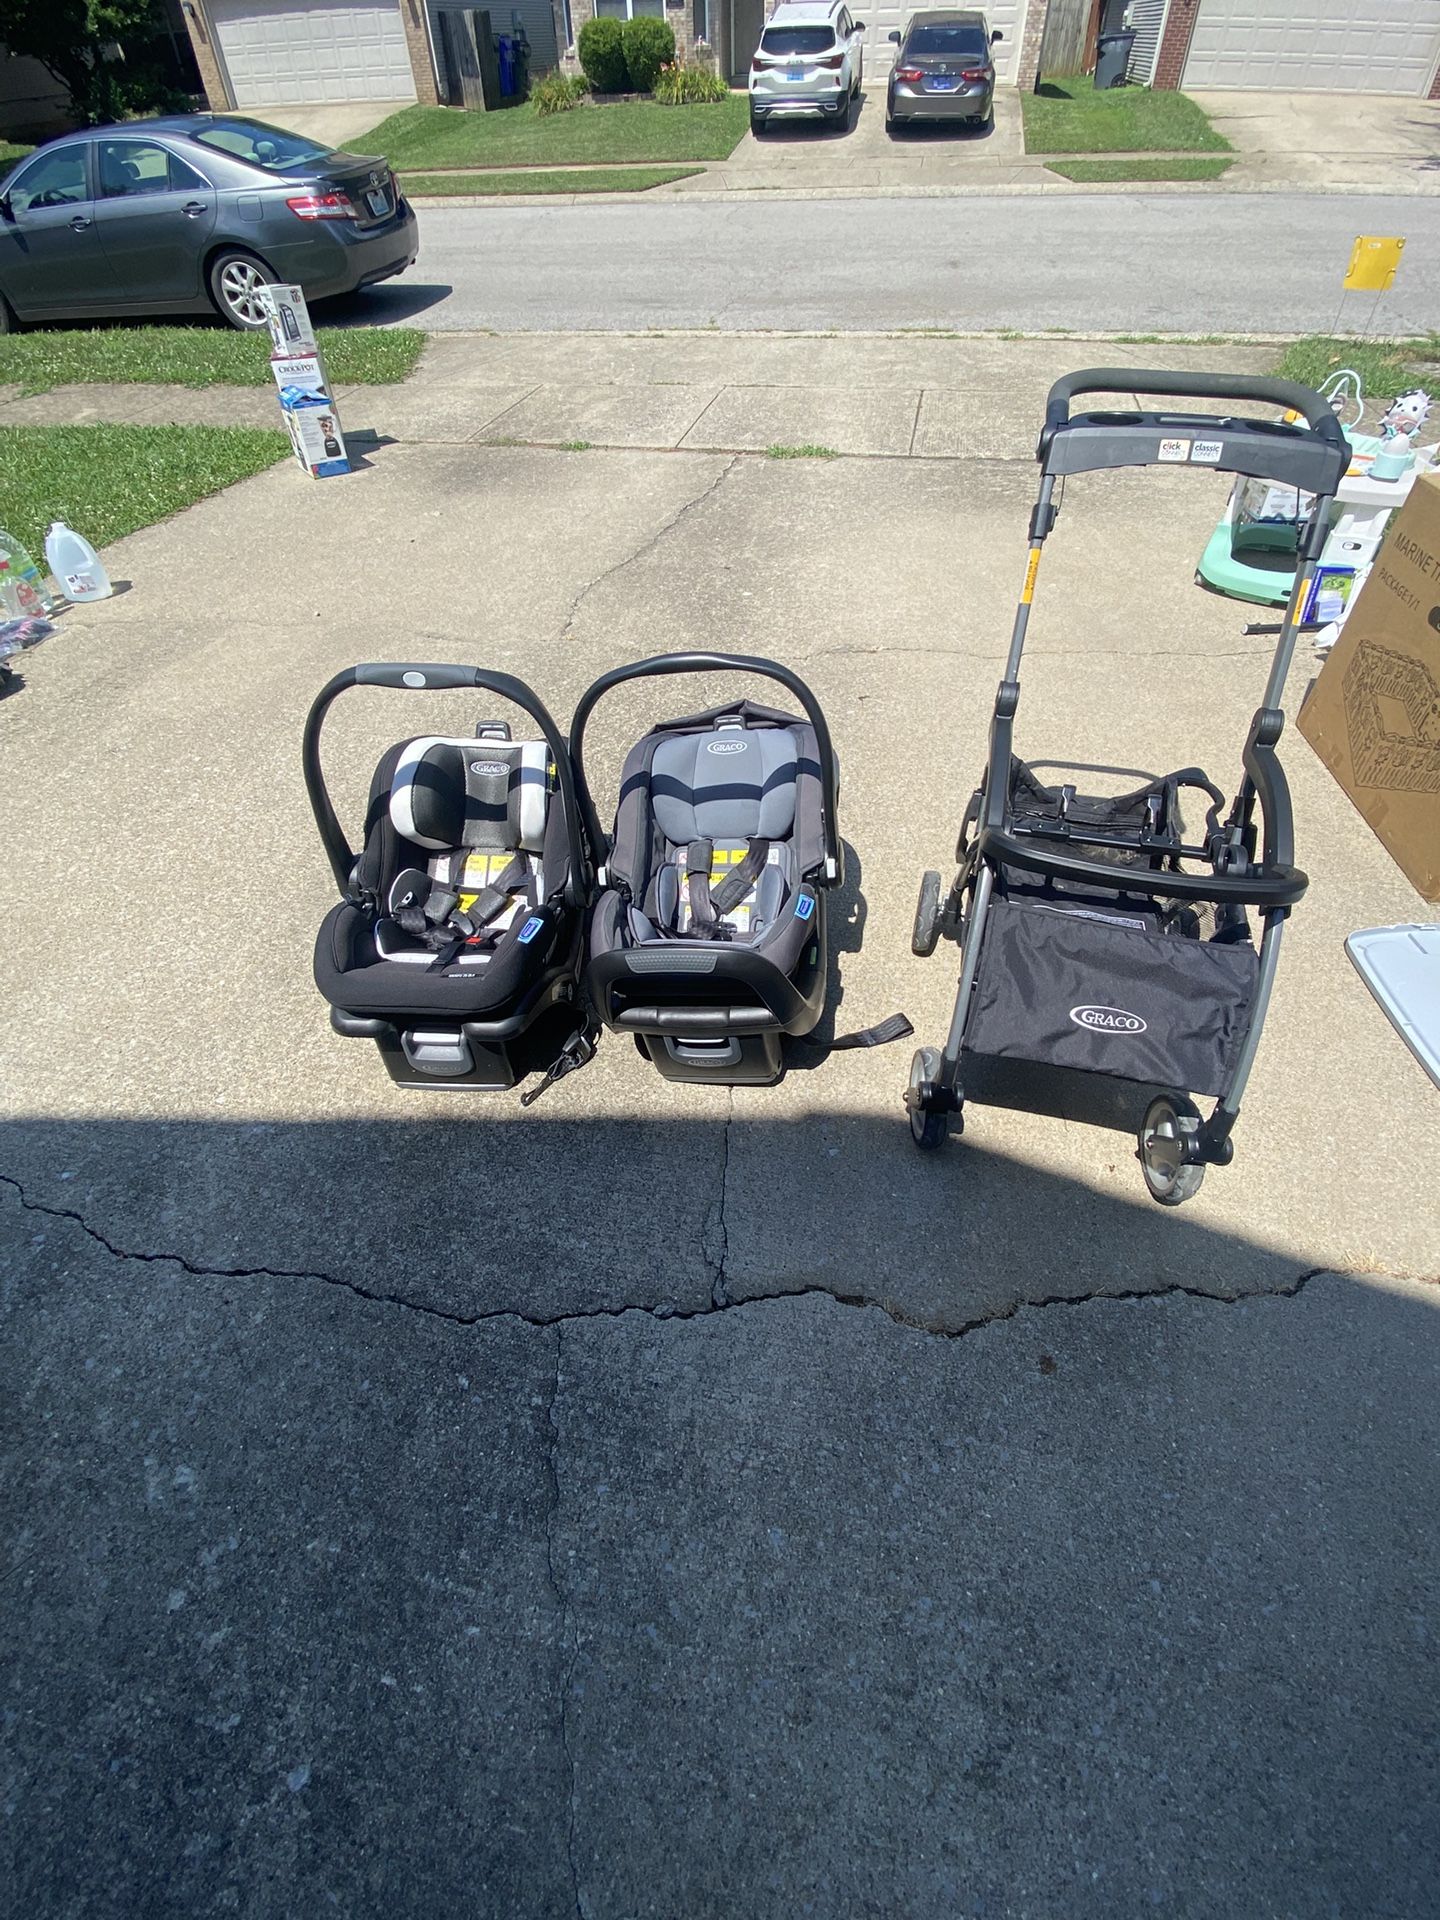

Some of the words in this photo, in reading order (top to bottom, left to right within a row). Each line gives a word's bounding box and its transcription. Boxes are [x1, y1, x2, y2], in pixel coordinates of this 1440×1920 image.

[1162, 441, 1181, 450] click
[1194, 443, 1220, 452] classic
[1394, 533, 1434, 572] MARINE
[712, 743, 743, 752] GRACO
[475, 763, 508, 773] GRACO
[1081, 1010, 1139, 1029] GRACO
